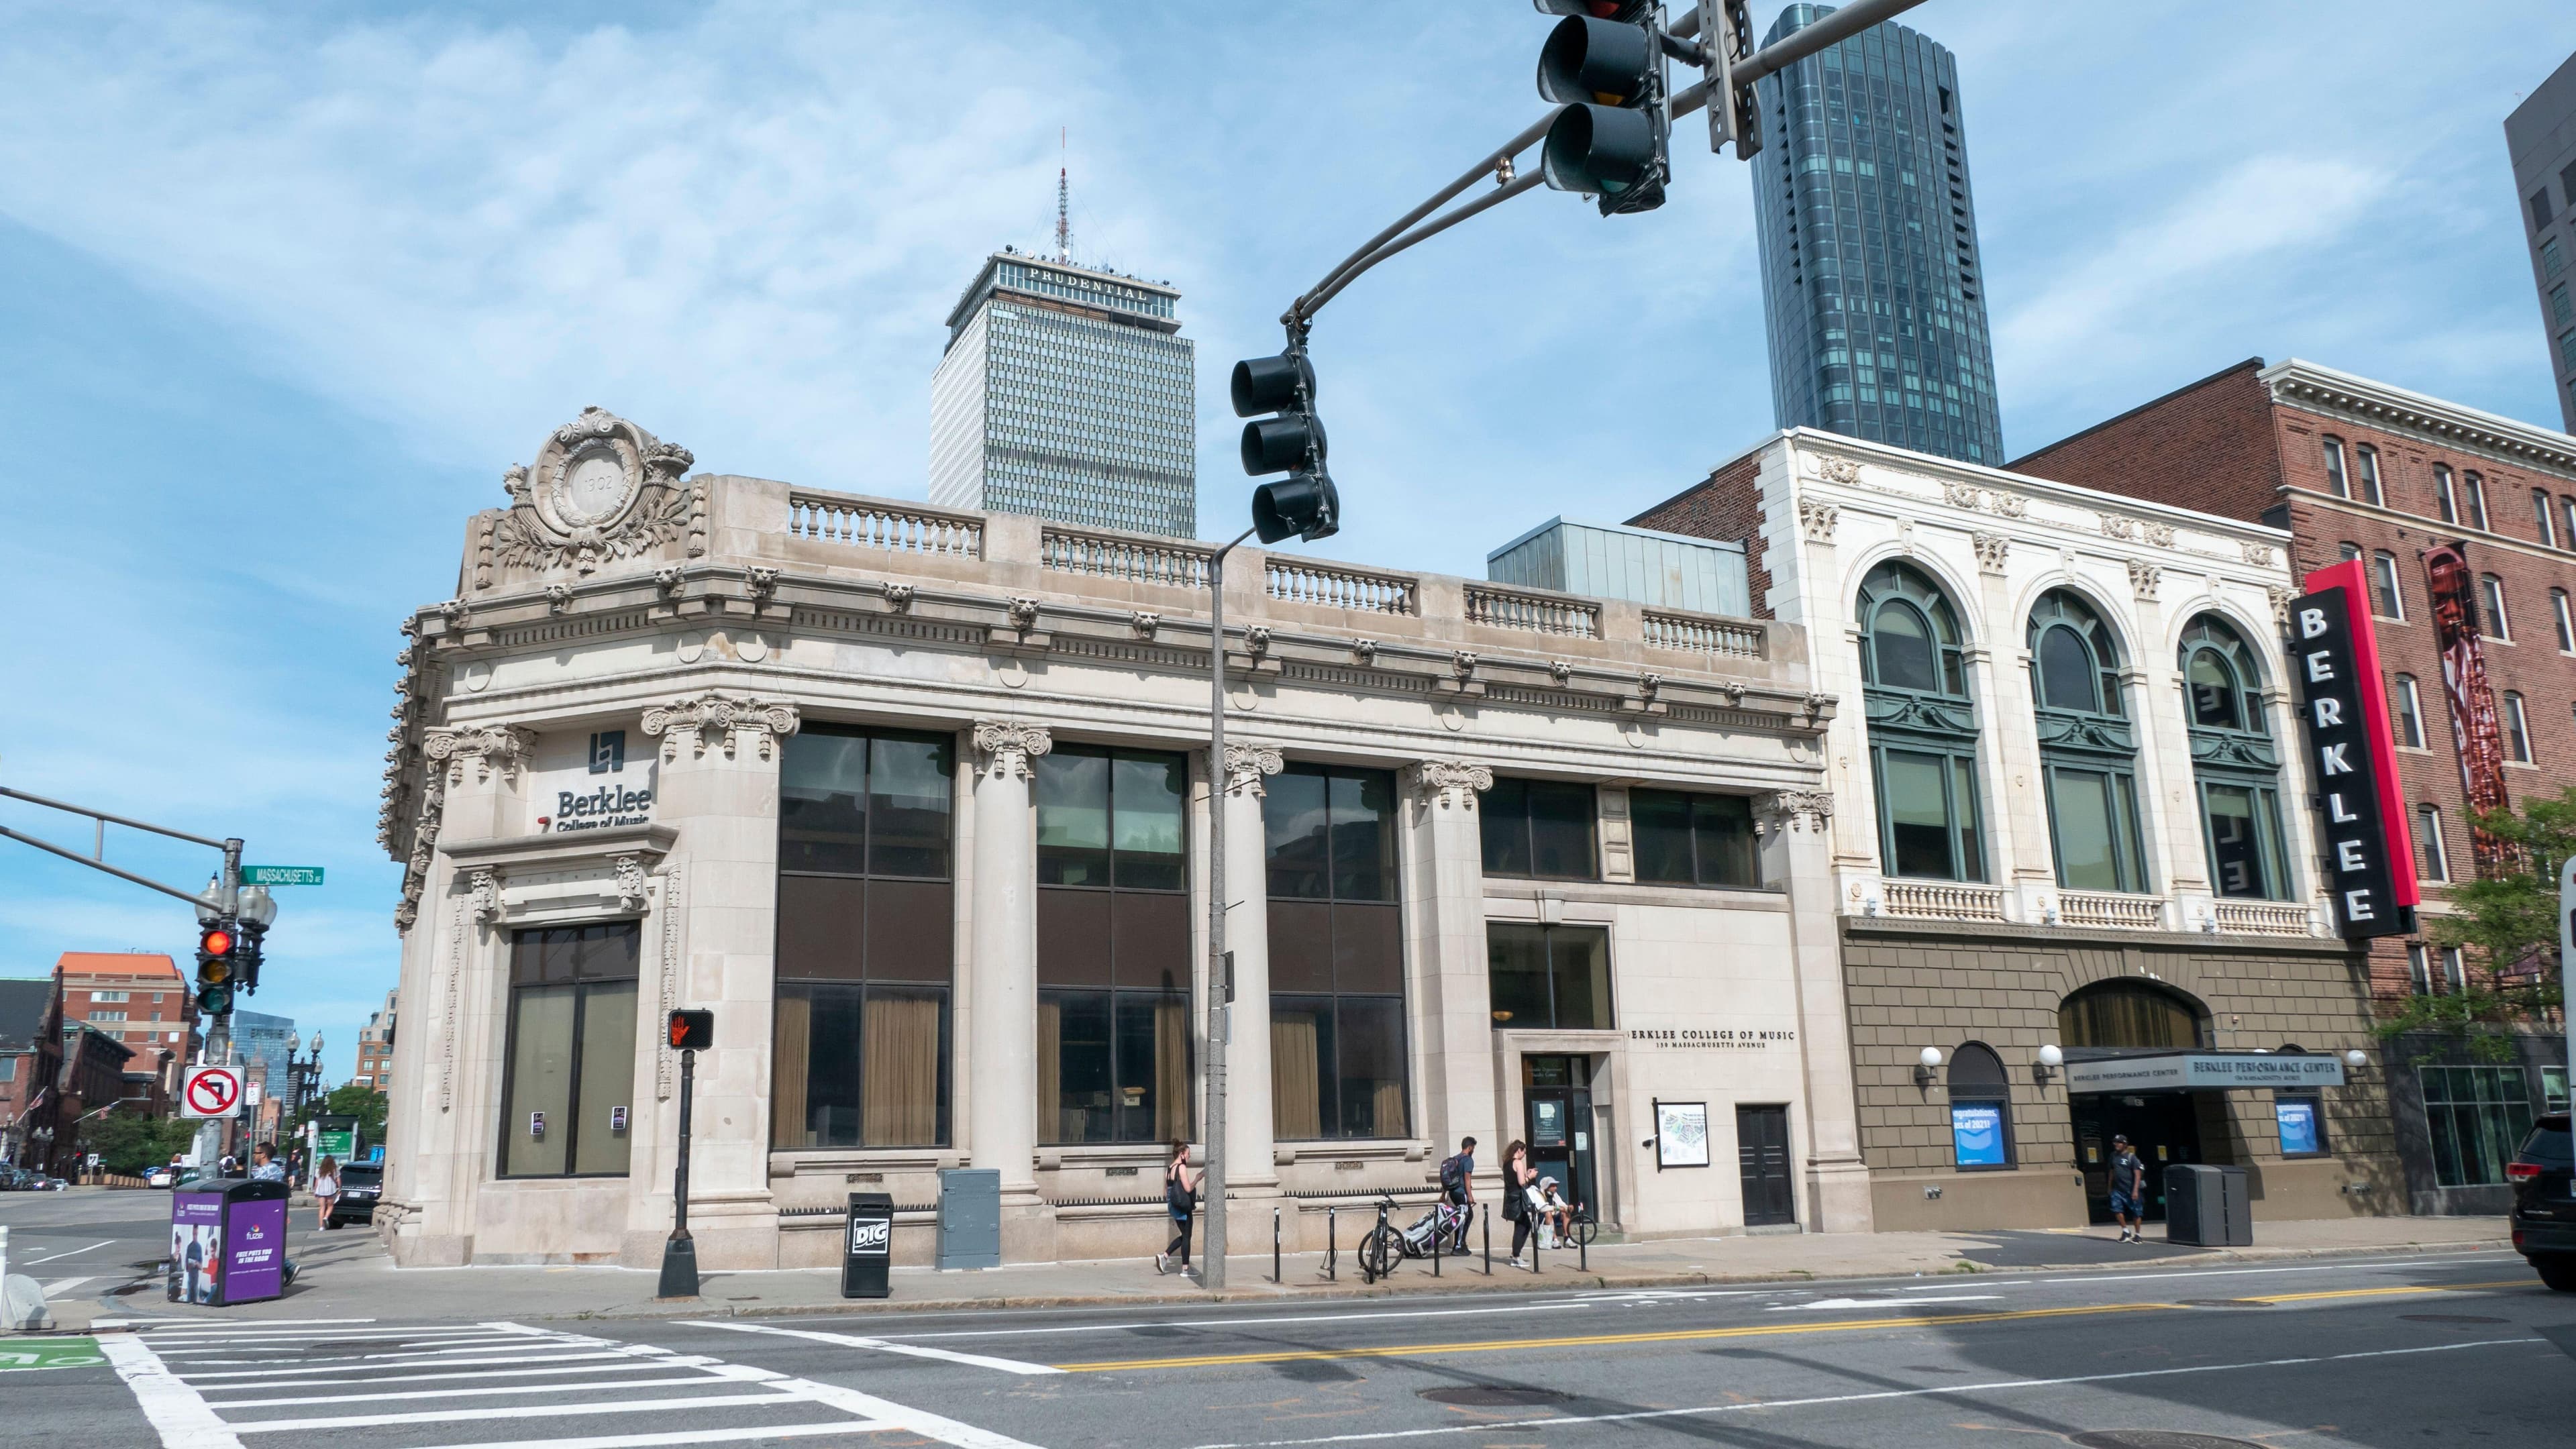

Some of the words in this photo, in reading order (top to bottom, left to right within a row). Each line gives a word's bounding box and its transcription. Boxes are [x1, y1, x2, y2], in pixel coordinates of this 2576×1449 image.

[1029, 268, 1147, 301] PRUDENTIAL
[2300, 608, 2375, 922] BERKLEE
[557, 784, 652, 818] Berklee
[256, 868, 314, 883] MASSACHUSETTS
[1682, 1030, 1734, 1039] COLLEGE
[1740, 1030, 1753, 1039] OF
[1759, 1031, 1795, 1040] MUSIC
[2102, 1070, 2151, 1079] PERFORMANCE
[2193, 1061, 2232, 1073] BERKLEE
[2235, 1062, 2301, 1073] PERFORMANCE
[2303, 1062, 2335, 1073] CENTER
[246, 1232, 264, 1240] fuze
[856, 1224, 886, 1244] DIG
